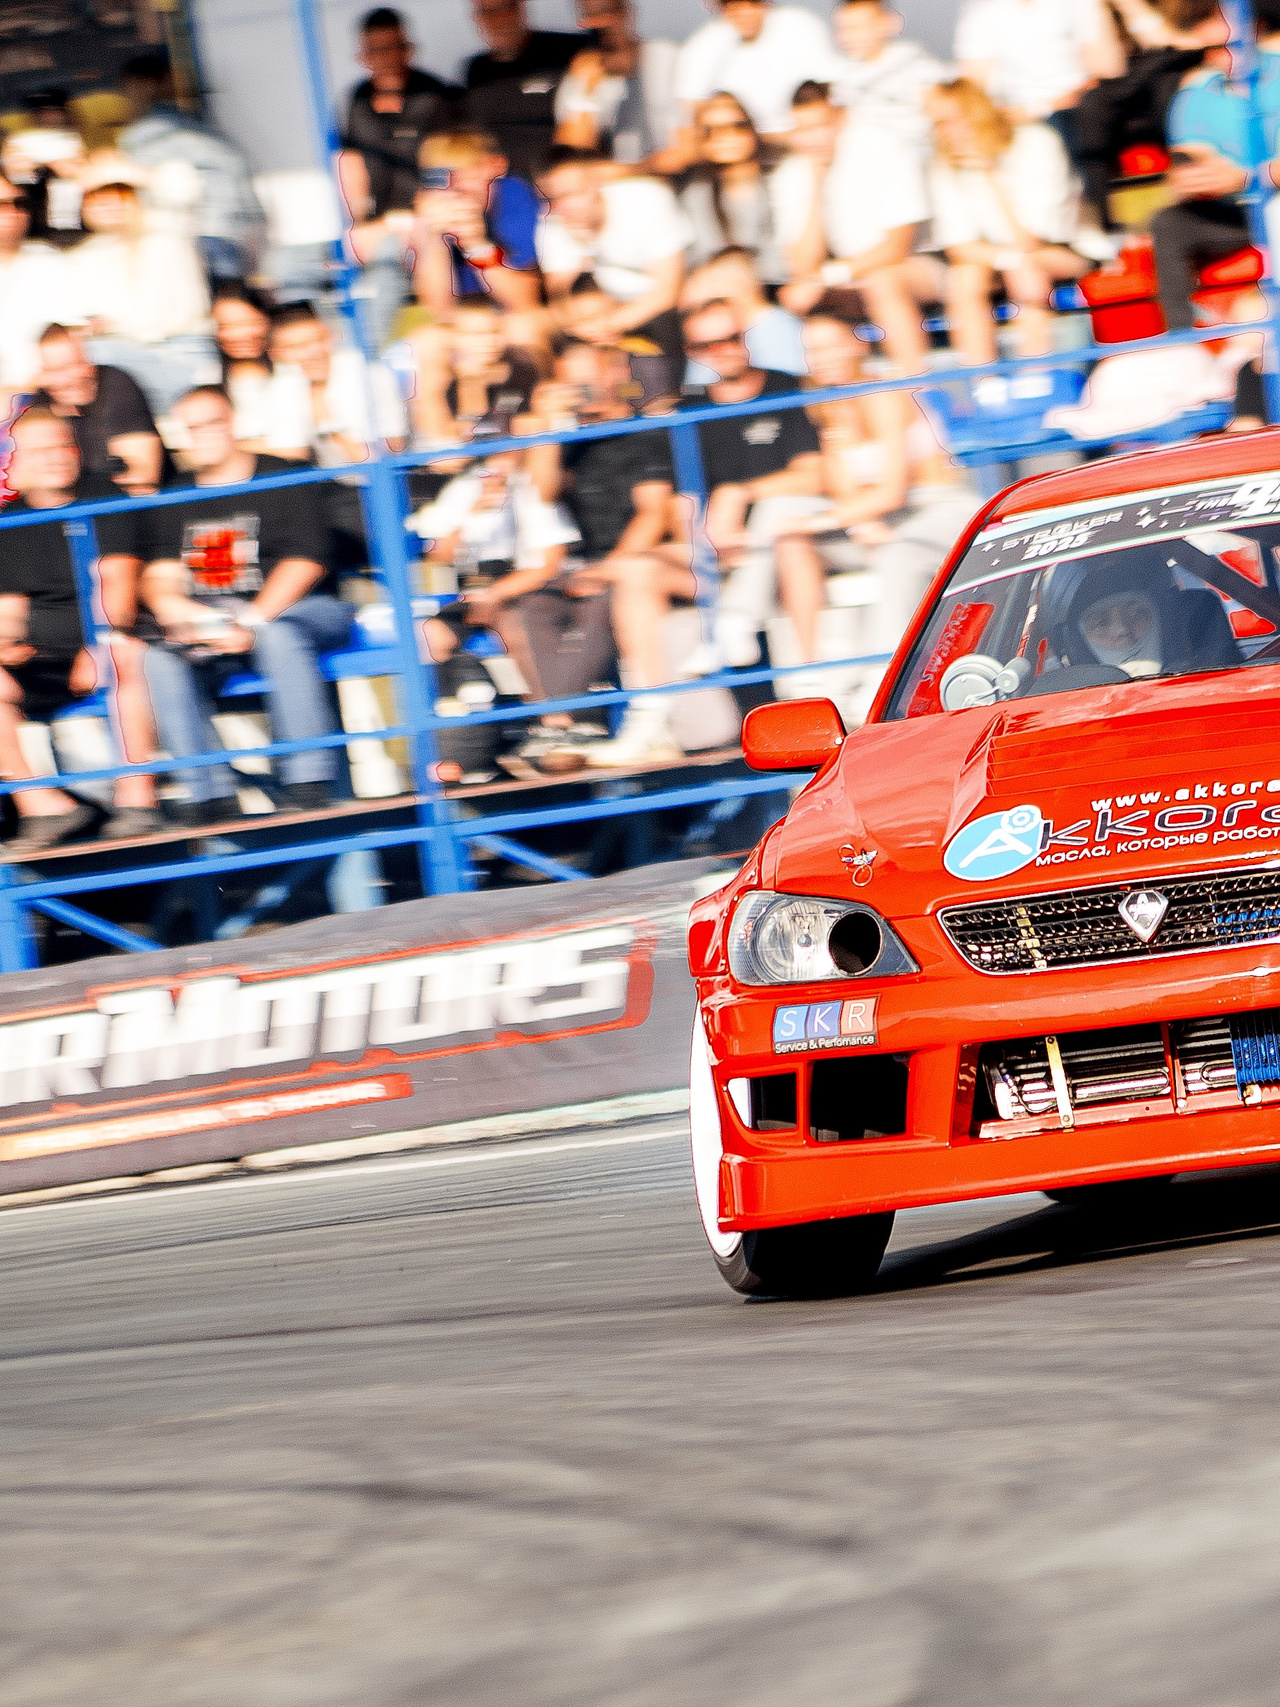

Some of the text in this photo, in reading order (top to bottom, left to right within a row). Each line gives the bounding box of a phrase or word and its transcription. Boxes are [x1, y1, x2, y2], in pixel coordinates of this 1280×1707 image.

[1021, 531, 1092, 561] 2025
[1035, 844, 1112, 867] масла,
[1116, 832, 1208, 854] которые
[780, 1002, 867, 1037] SKR
[775, 1041, 808, 1054] Service
[808, 1038, 818, 1050] &
